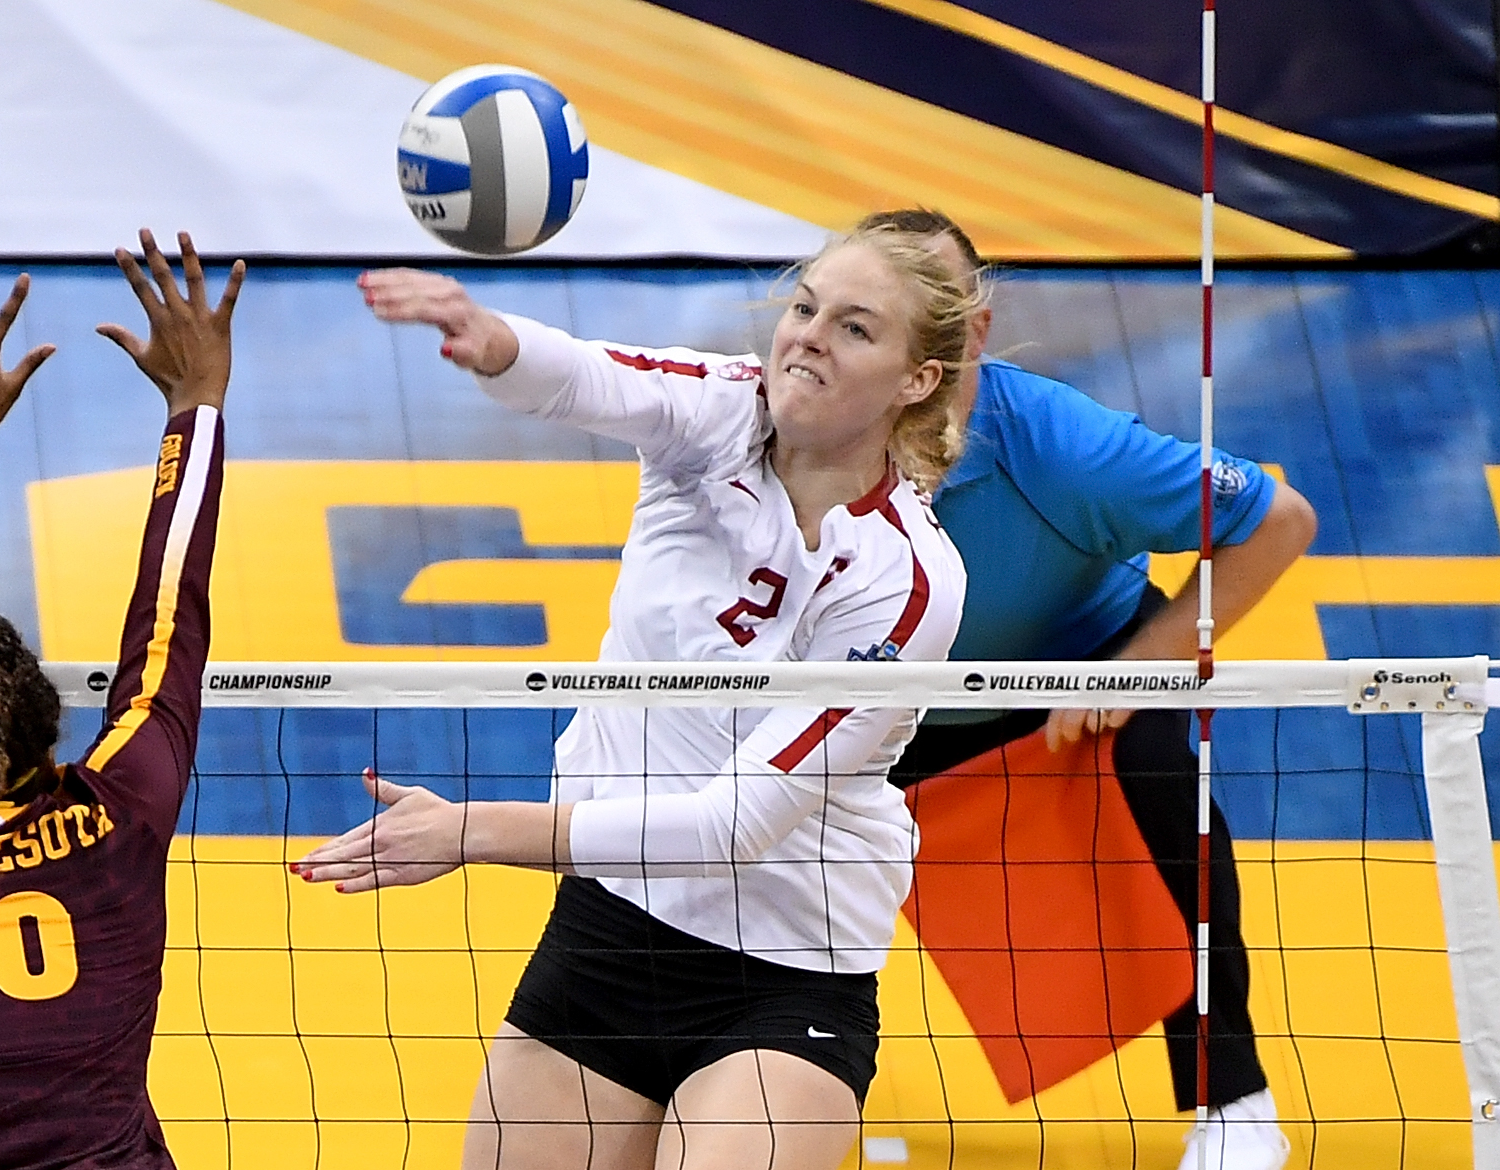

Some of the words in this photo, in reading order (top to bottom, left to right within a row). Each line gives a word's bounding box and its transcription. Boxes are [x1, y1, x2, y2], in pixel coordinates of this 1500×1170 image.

[716, 567, 788, 648] 2
[209, 675, 332, 690] CHAMPIONSHIP
[551, 675, 643, 690] VOLLEYBALL
[647, 675, 771, 690] CHAMPIONSHIP
[989, 675, 1081, 690] VOLLEYBALL
[1086, 675, 1208, 690] CHAMPIONSHIP
[1391, 672, 1452, 684] Senoh
